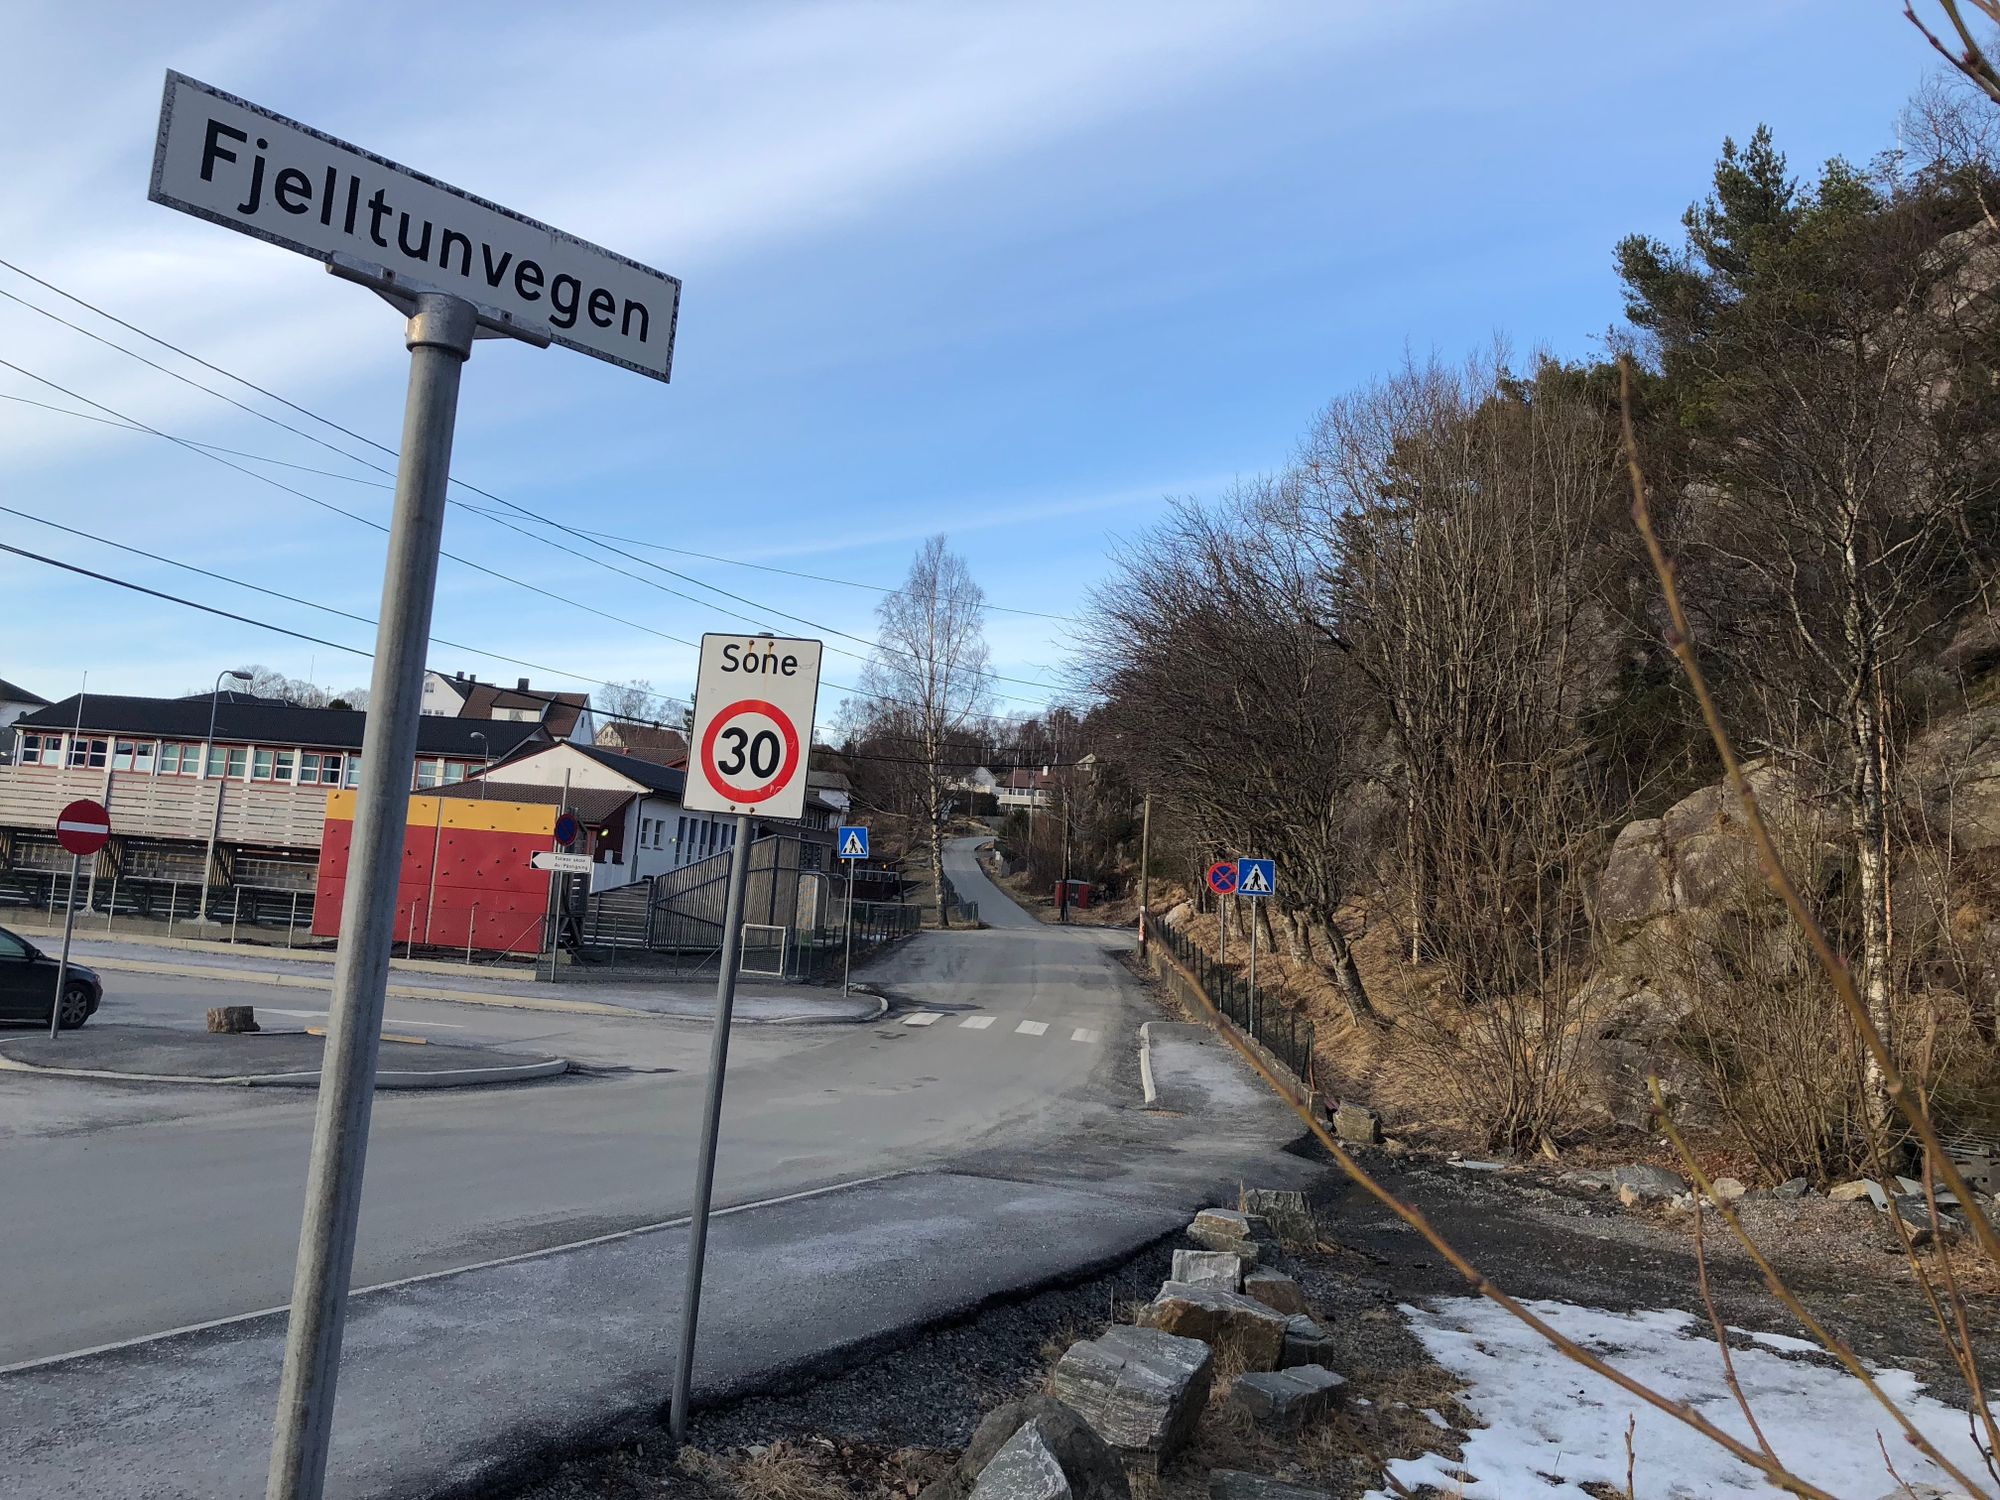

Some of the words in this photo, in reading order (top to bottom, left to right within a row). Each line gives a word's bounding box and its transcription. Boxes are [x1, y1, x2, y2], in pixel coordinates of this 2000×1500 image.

[200, 118, 651, 343] Fjelltunvegen
[721, 643, 798, 677] Sone
[718, 726, 781, 779] 30
